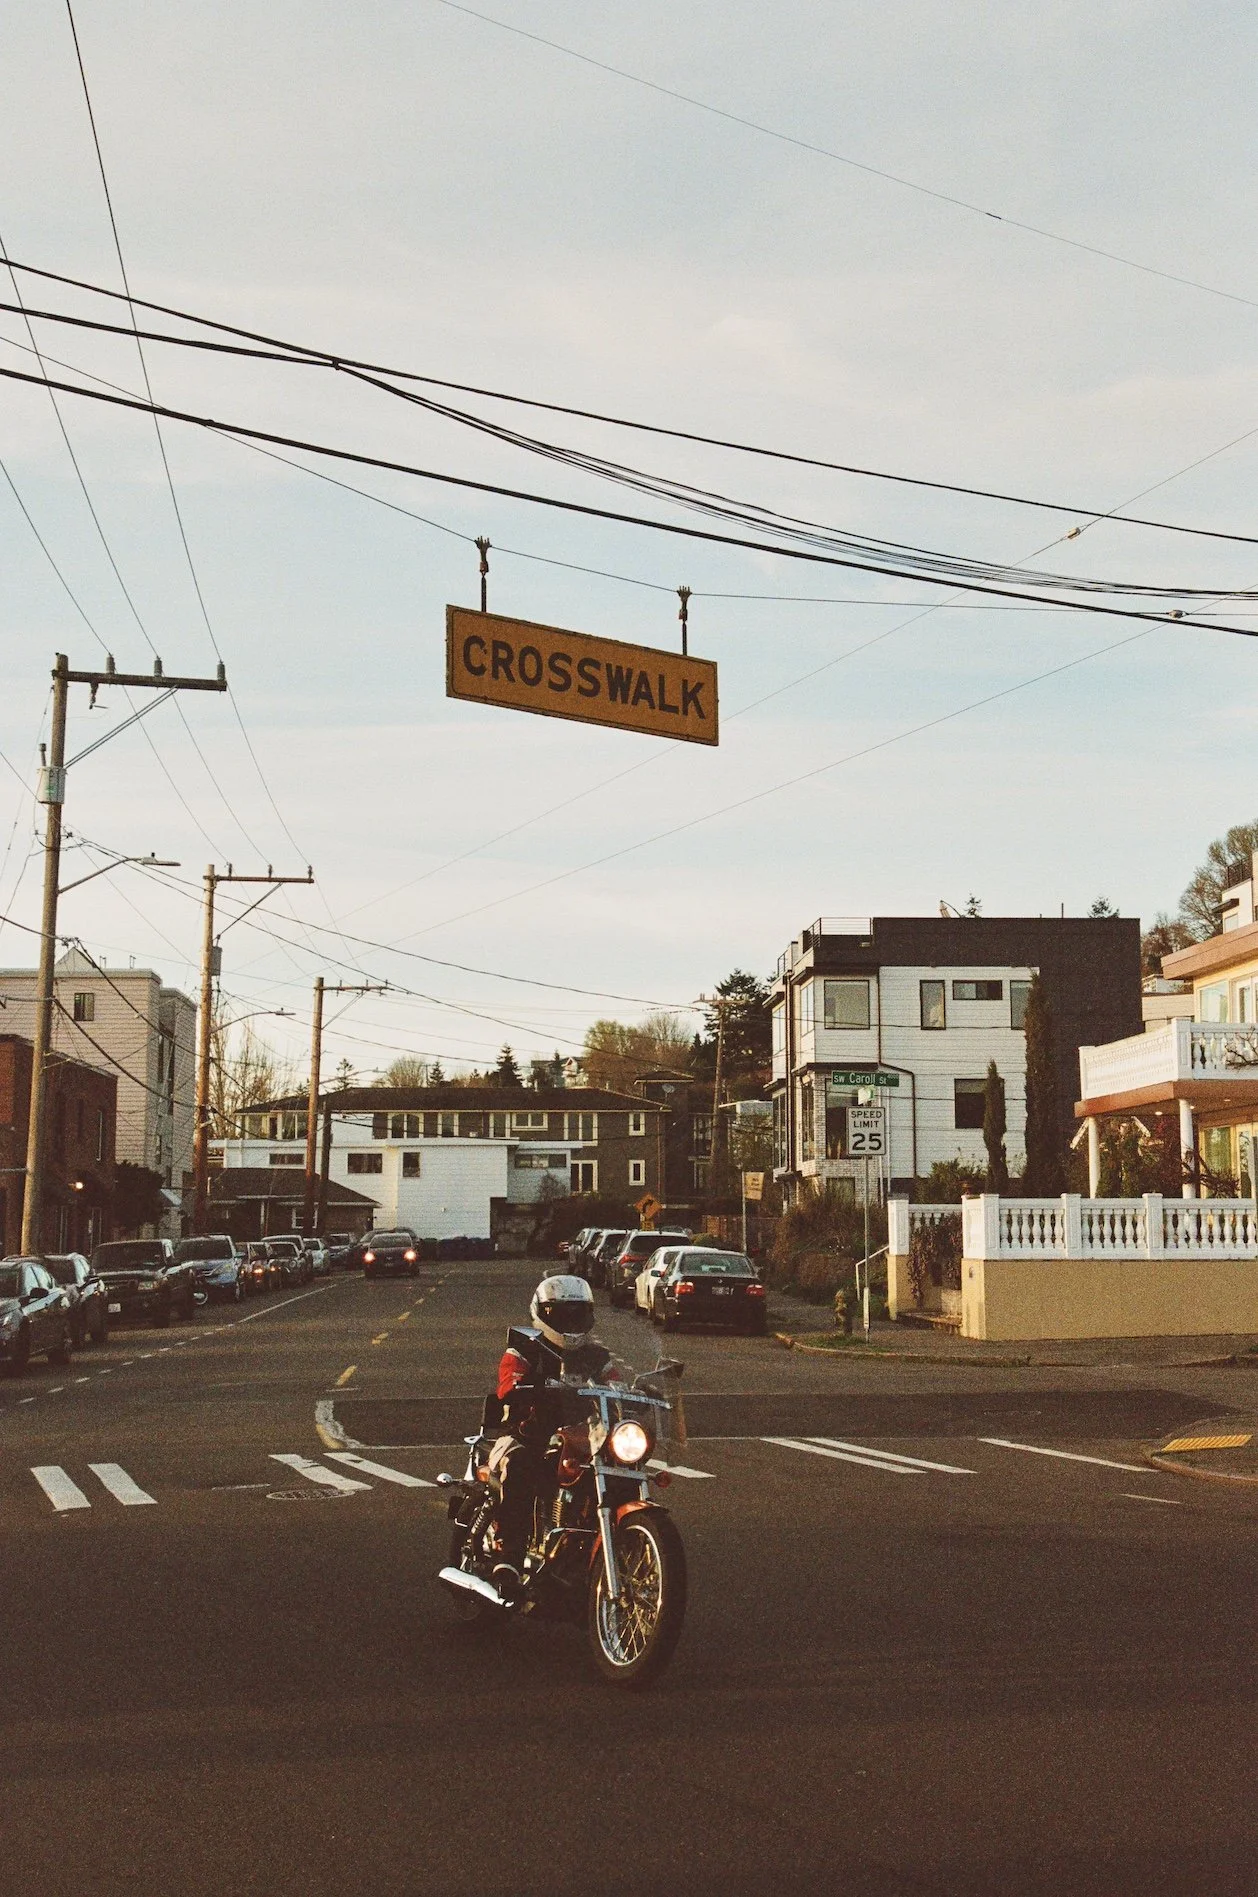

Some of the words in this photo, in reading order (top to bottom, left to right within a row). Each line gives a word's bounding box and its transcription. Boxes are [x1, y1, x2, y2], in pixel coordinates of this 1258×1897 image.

[462, 634, 706, 720] CROSSWALK
[849, 1072, 876, 1084] Caroll
[852, 1133, 882, 1151] 25
